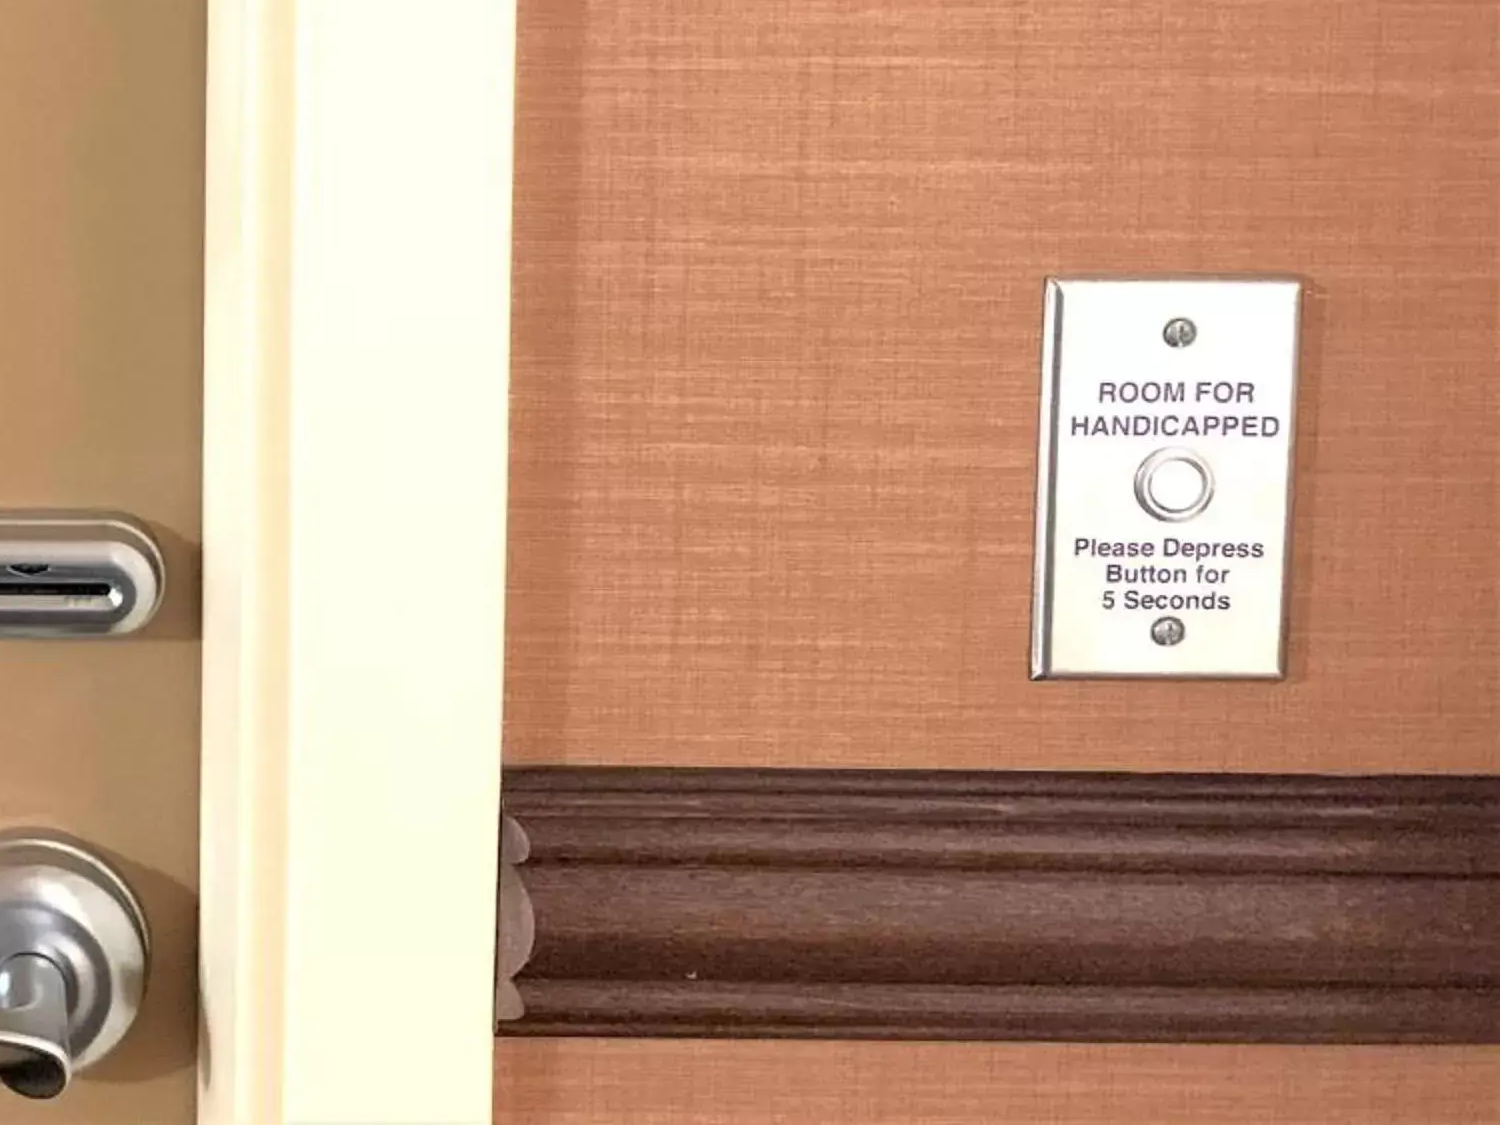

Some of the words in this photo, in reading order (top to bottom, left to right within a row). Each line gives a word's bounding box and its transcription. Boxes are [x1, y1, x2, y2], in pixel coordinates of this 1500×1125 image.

[1099, 381, 1185, 404] ROOM
[1195, 381, 1255, 404] FOR
[1071, 415, 1280, 438] HANDICAPPED
[1074, 538, 1155, 558] Please
[1163, 538, 1265, 562] Depress
[1106, 564, 1187, 584] Button
[1196, 564, 1230, 584] for
[1102, 591, 1115, 610] 5
[1123, 590, 1231, 610] Seconds
